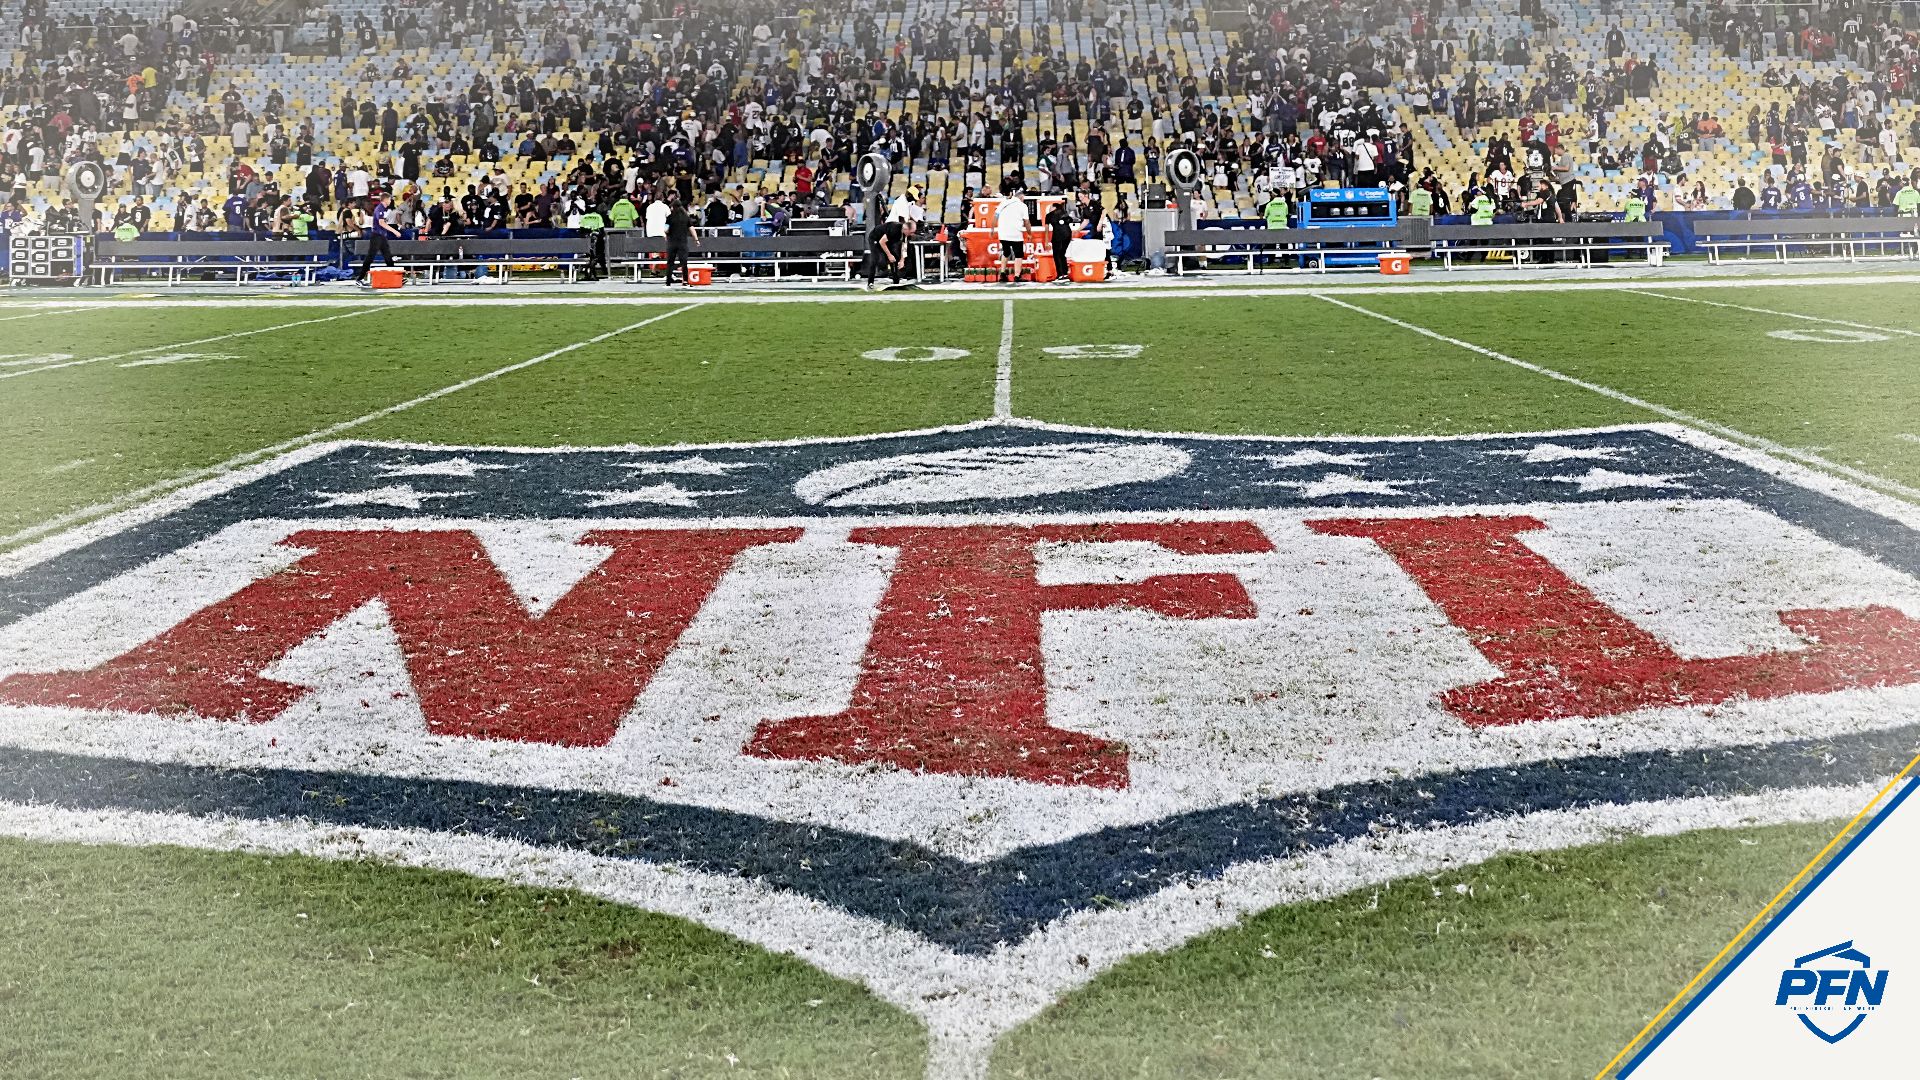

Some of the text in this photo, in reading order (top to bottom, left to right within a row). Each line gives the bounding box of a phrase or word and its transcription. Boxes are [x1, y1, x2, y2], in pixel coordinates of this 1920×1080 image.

[183, 29, 192, 38] 17
[365, 32, 370, 40] 8
[1890, 73, 1898, 83] 15
[826, 87, 836, 97] 22
[1342, 137, 1355, 147] 88
[1387, 144, 1392, 153] 8
[1769, 195, 1775, 206] 4
[1799, 191, 1806, 201] 8
[235, 205, 241, 215] 8
[978, 203, 989, 215] G
[135, 211, 142, 222] 9
[1082, 264, 1094, 276] G
[1391, 260, 1402, 272] G
[688, 271, 700, 282] G
[0, 514, 1920, 790] NFL
